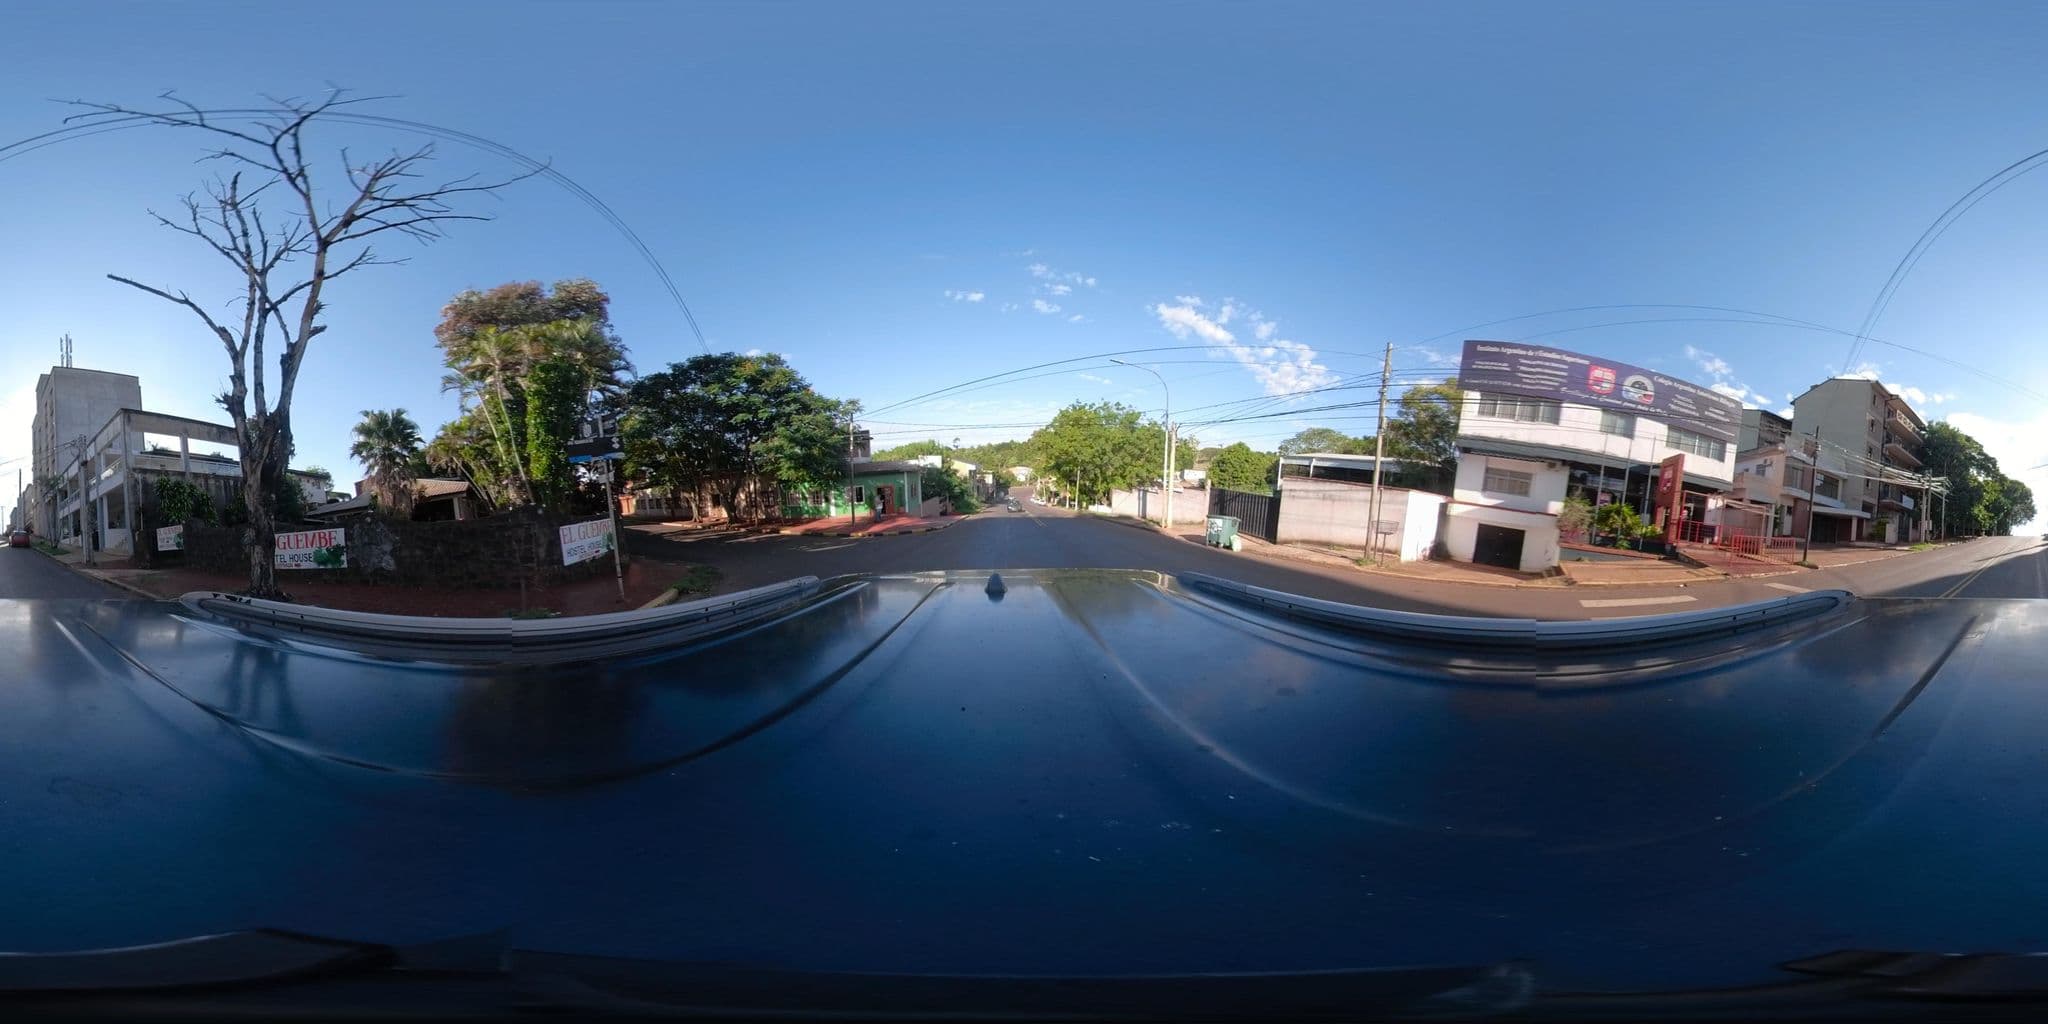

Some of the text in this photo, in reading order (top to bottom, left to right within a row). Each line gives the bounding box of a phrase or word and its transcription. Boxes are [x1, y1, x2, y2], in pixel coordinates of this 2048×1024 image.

[276, 531, 337, 549] GUEMBE
[561, 527, 576, 545] EL
[289, 552, 313, 563] HOUSE
